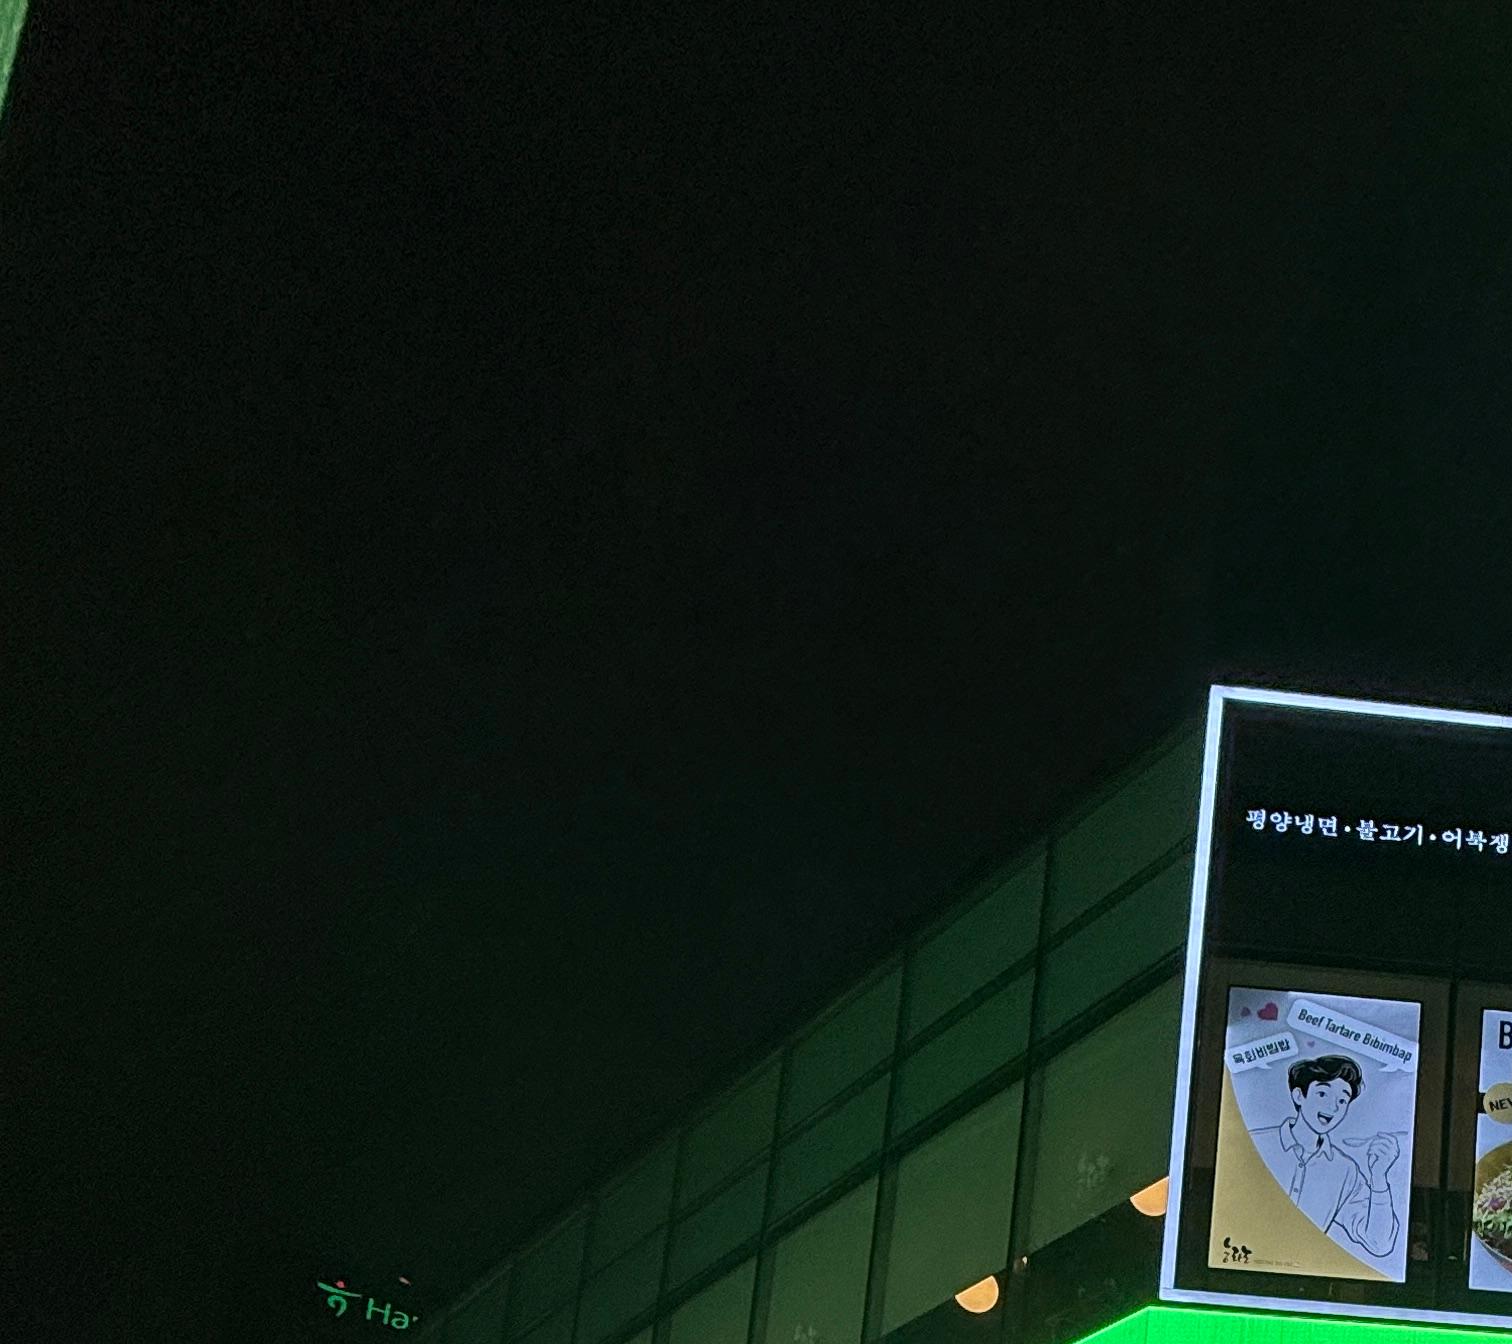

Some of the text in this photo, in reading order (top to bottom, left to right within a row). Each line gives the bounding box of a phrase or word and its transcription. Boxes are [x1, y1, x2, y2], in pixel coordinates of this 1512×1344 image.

[1246, 809, 1338, 837] 평양냉면
[1355, 818, 1424, 846] 불고기
[1232, 1038, 1291, 1065] 육회비빔밥
[1298, 1008, 1413, 1064] Beef Tartare Bibimbap
[366, 1297, 419, 1330] Ha
